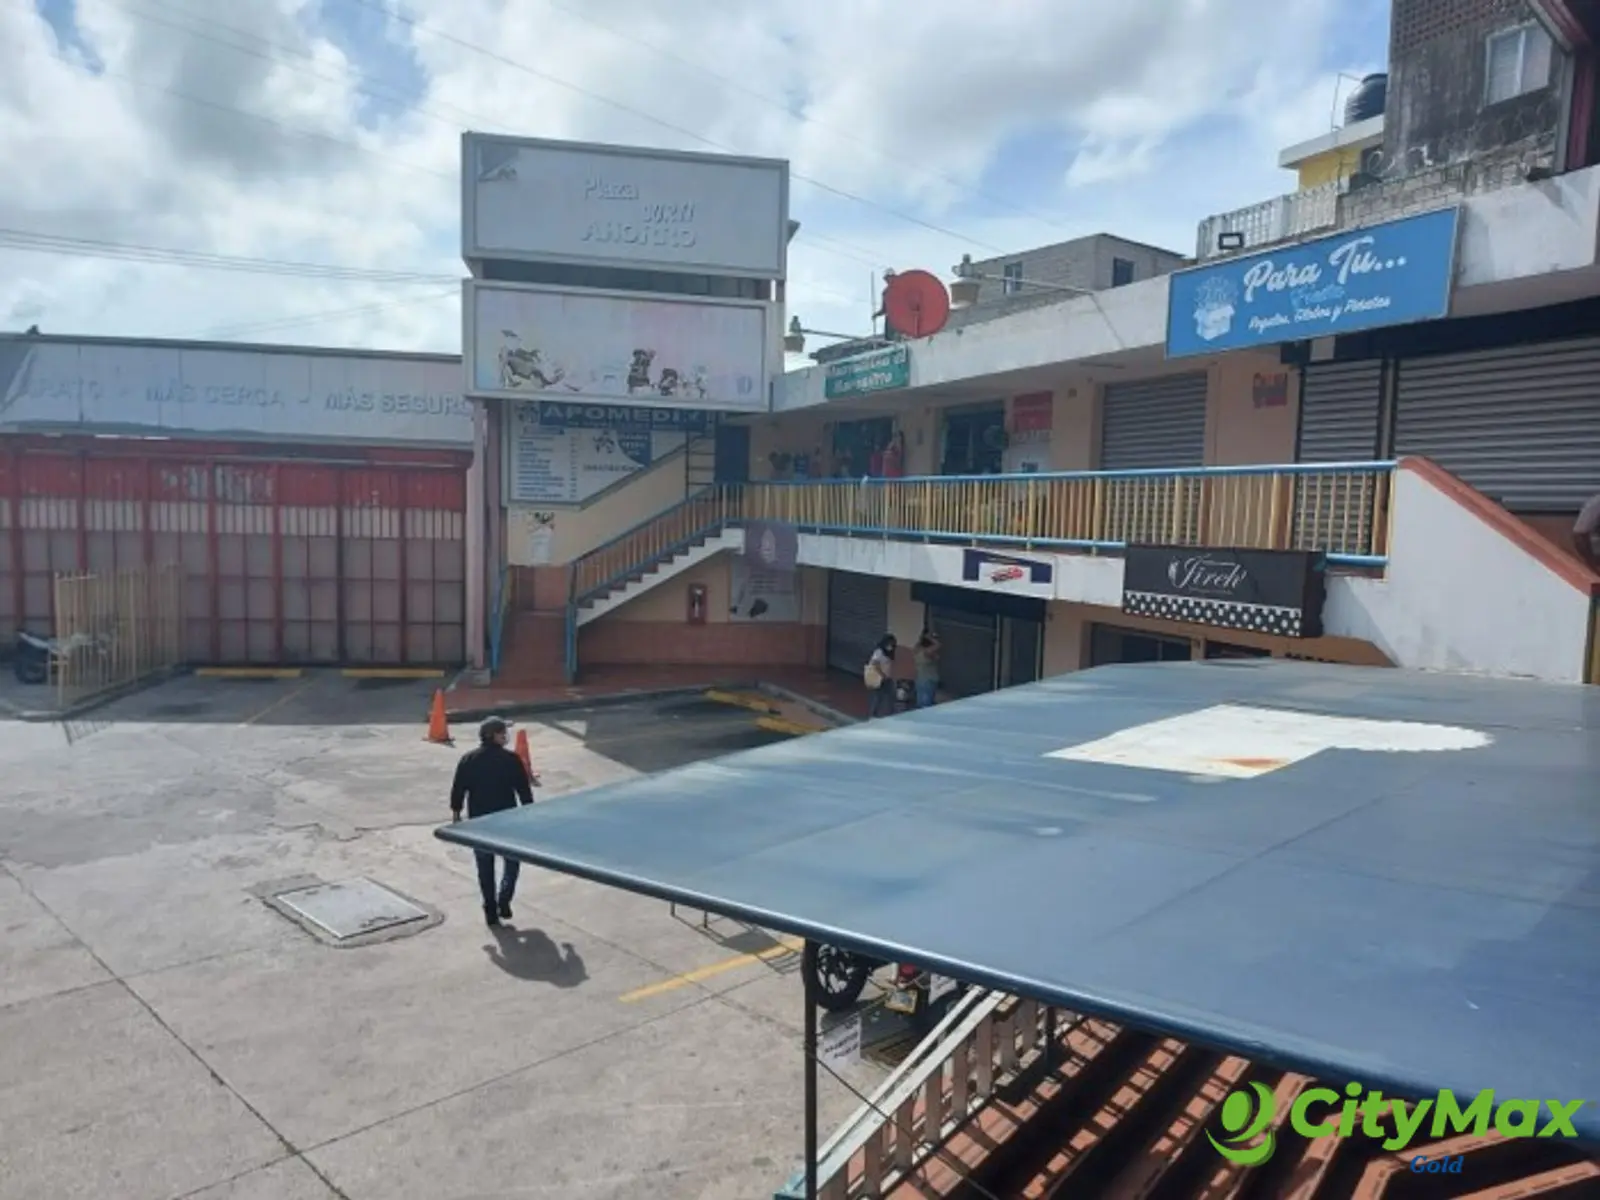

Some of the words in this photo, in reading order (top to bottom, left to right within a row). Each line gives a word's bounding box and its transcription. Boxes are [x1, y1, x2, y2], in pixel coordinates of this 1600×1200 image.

[584, 174, 640, 200] Plaza
[1244, 259, 1323, 304] Para
[325, 385, 375, 413] MÁS
